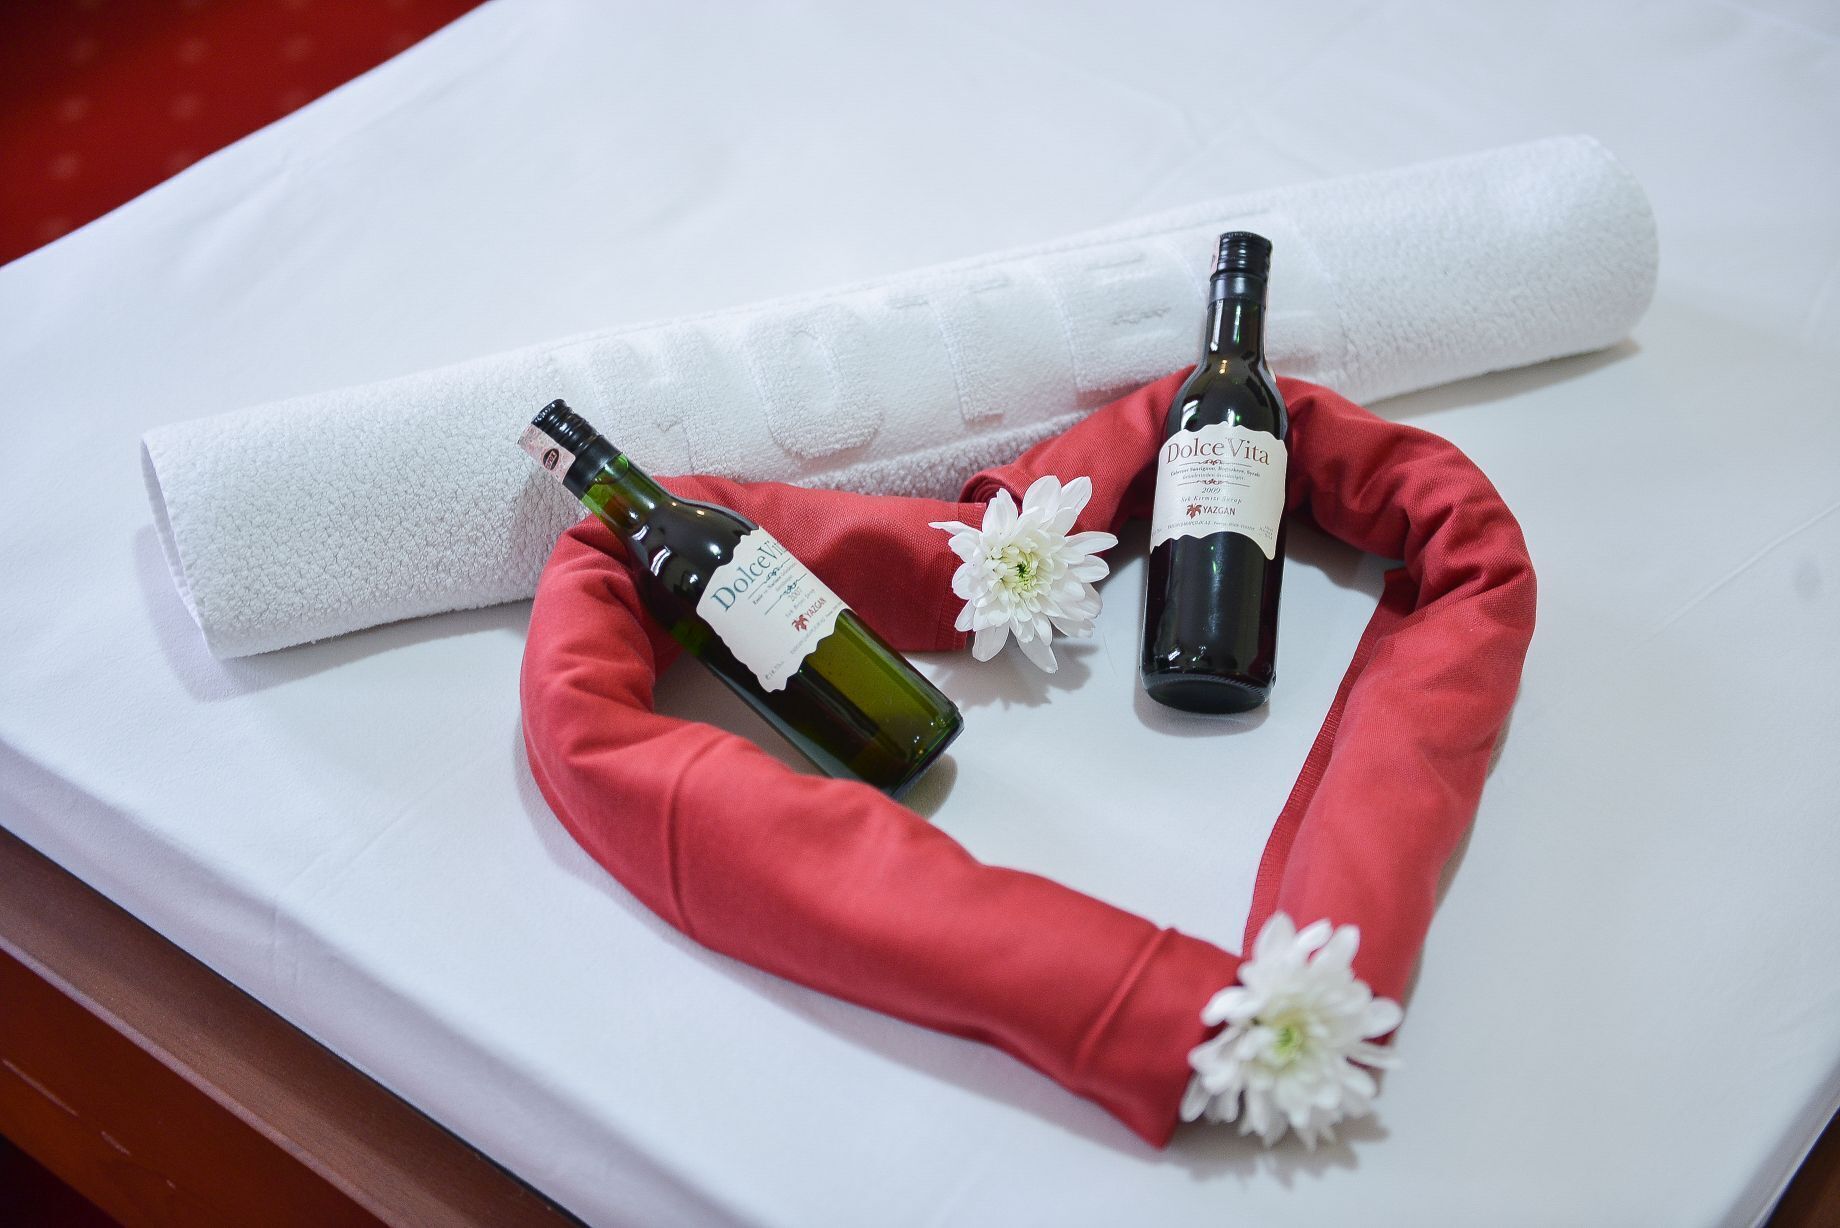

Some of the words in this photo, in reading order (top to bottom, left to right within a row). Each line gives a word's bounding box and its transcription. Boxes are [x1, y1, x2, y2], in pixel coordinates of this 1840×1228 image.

[1167, 437, 1225, 465] Dolce
[1227, 437, 1270, 466] Vita
[1203, 505, 1237, 517] YAZGAN
[710, 554, 772, 613] Dolce
[805, 597, 828, 618] YAZGAN
